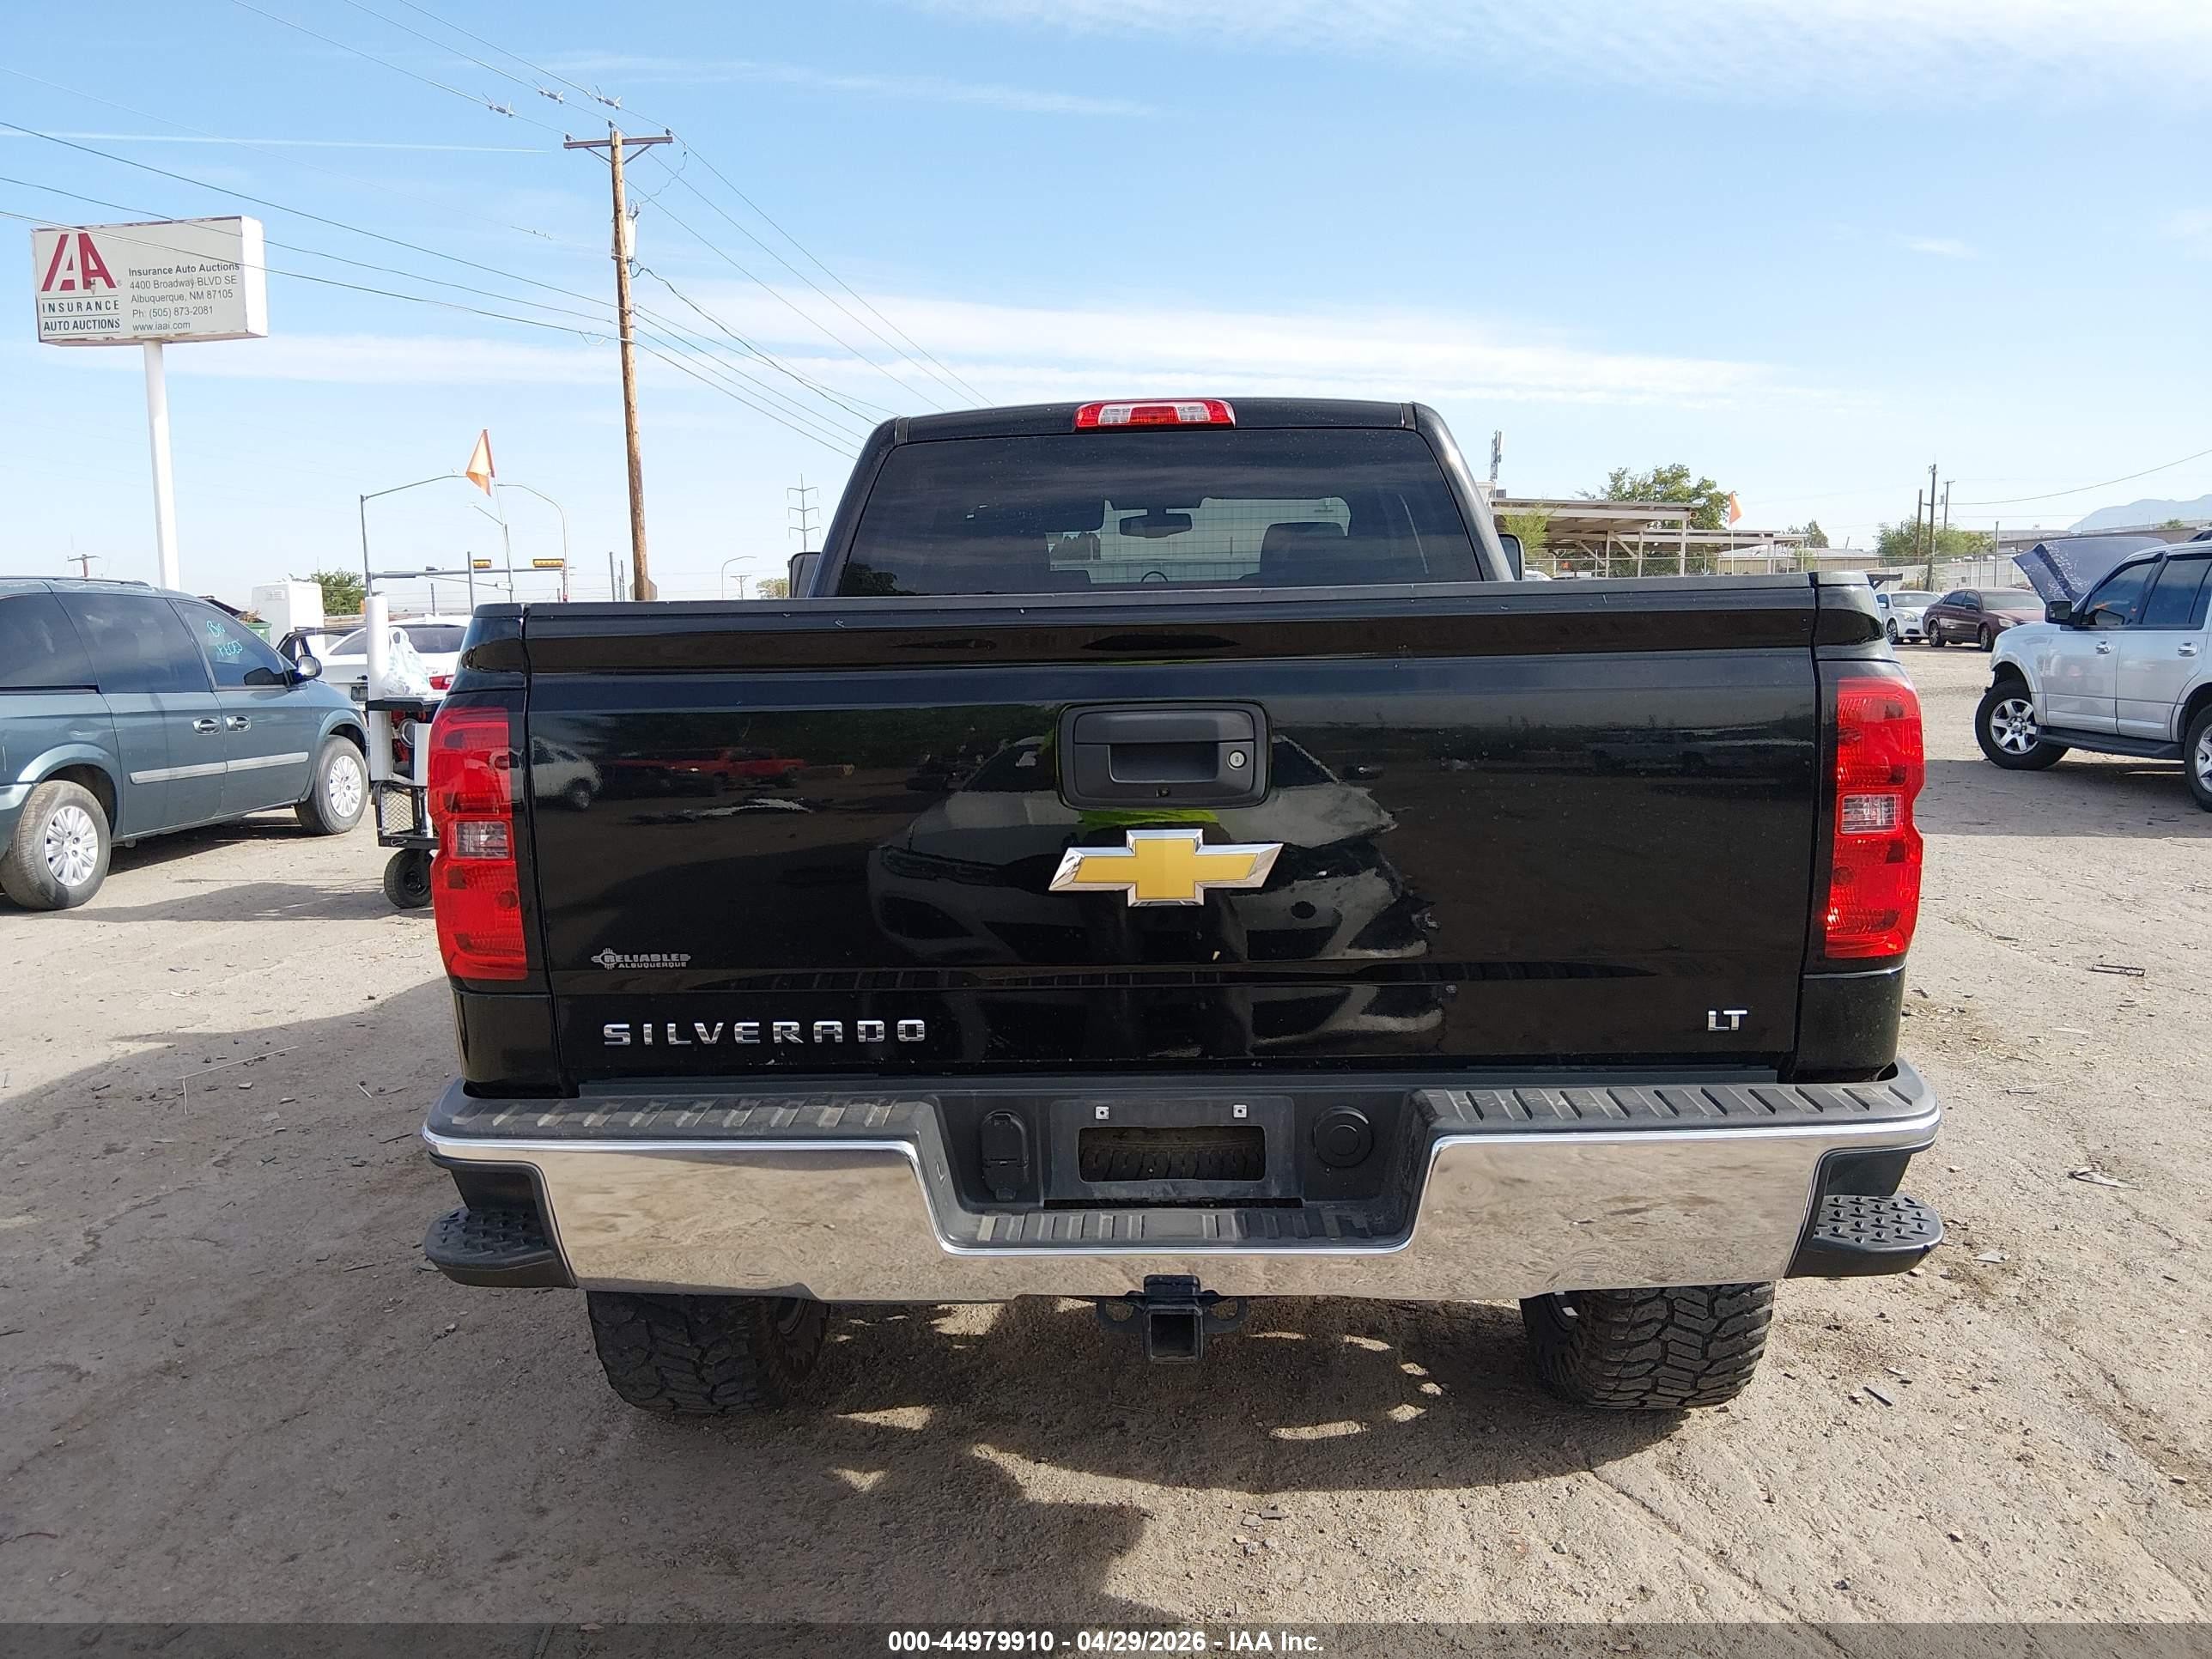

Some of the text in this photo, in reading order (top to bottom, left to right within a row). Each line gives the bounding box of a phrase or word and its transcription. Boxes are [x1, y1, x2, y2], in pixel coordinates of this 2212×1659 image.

[129, 262, 240, 276] Insurance Auto Auctions
[130, 275, 238, 289] 4400 Broadway BLVD SE
[131, 289, 234, 304] Albuquerque, NM 87105
[42, 300, 119, 313] INSURANCE
[149, 308, 172, 319] (505)
[173, 306, 213, 316] 873-2081
[43, 318, 120, 331] AUTO AUCTIONS
[132, 322, 191, 331] www.iaai.com
[1708, 1010, 1748, 1031] LT
[604, 1019, 926, 1045] SILVERADO
